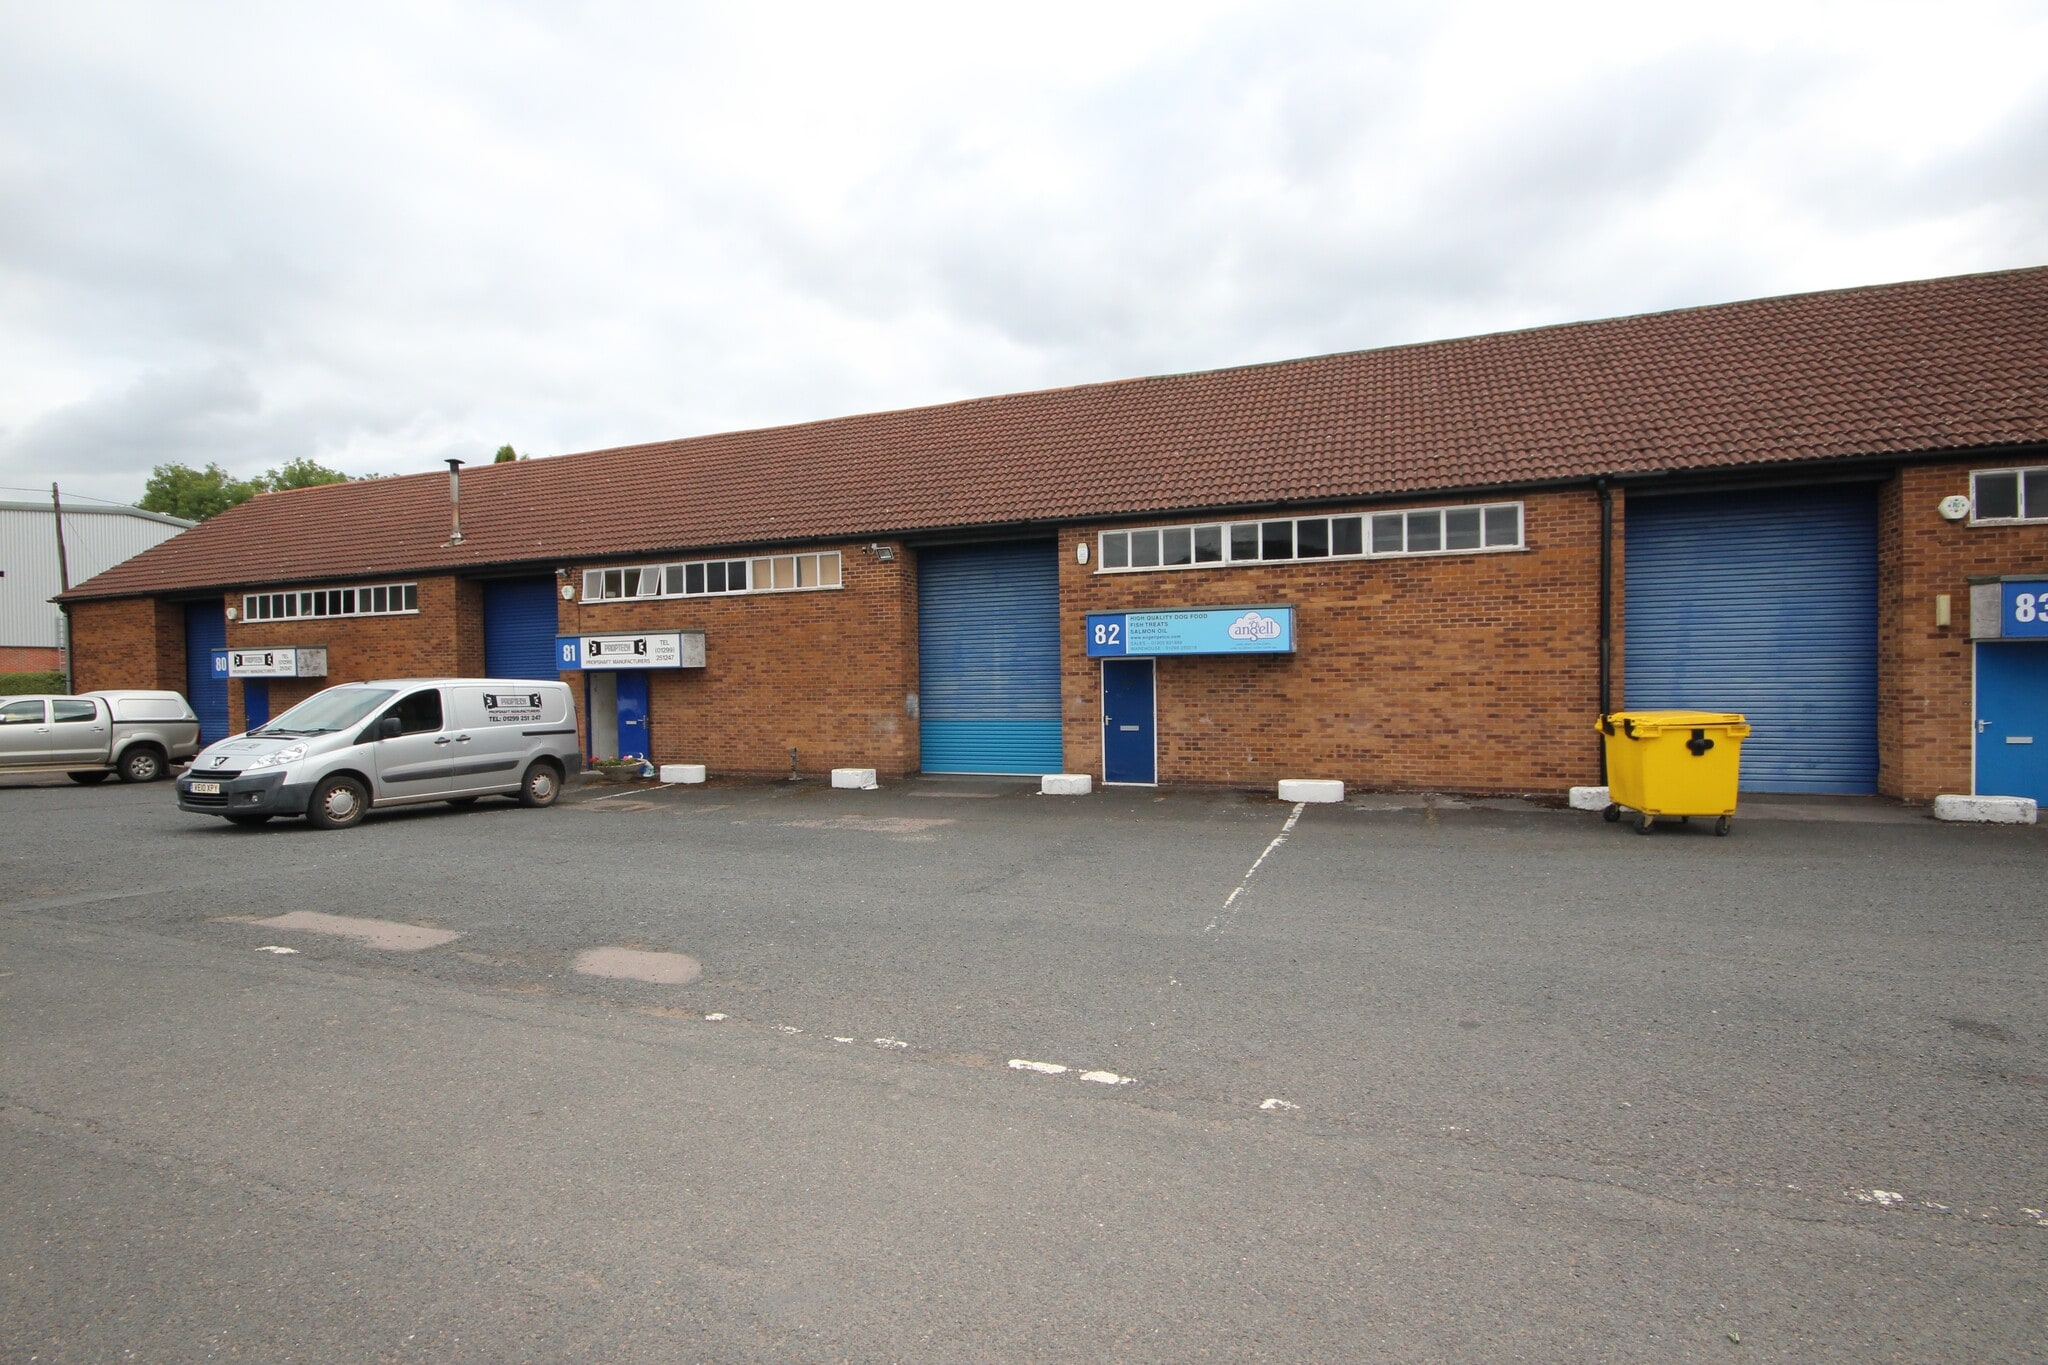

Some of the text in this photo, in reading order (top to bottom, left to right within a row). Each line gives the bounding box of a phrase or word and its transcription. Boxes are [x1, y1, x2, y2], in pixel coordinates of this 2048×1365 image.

[1095, 624, 1120, 645] 82
[1234, 621, 1273, 642] angell
[562, 644, 576, 662] 81
[604, 643, 631, 652] PROPTECH
[215, 657, 227, 671] 80
